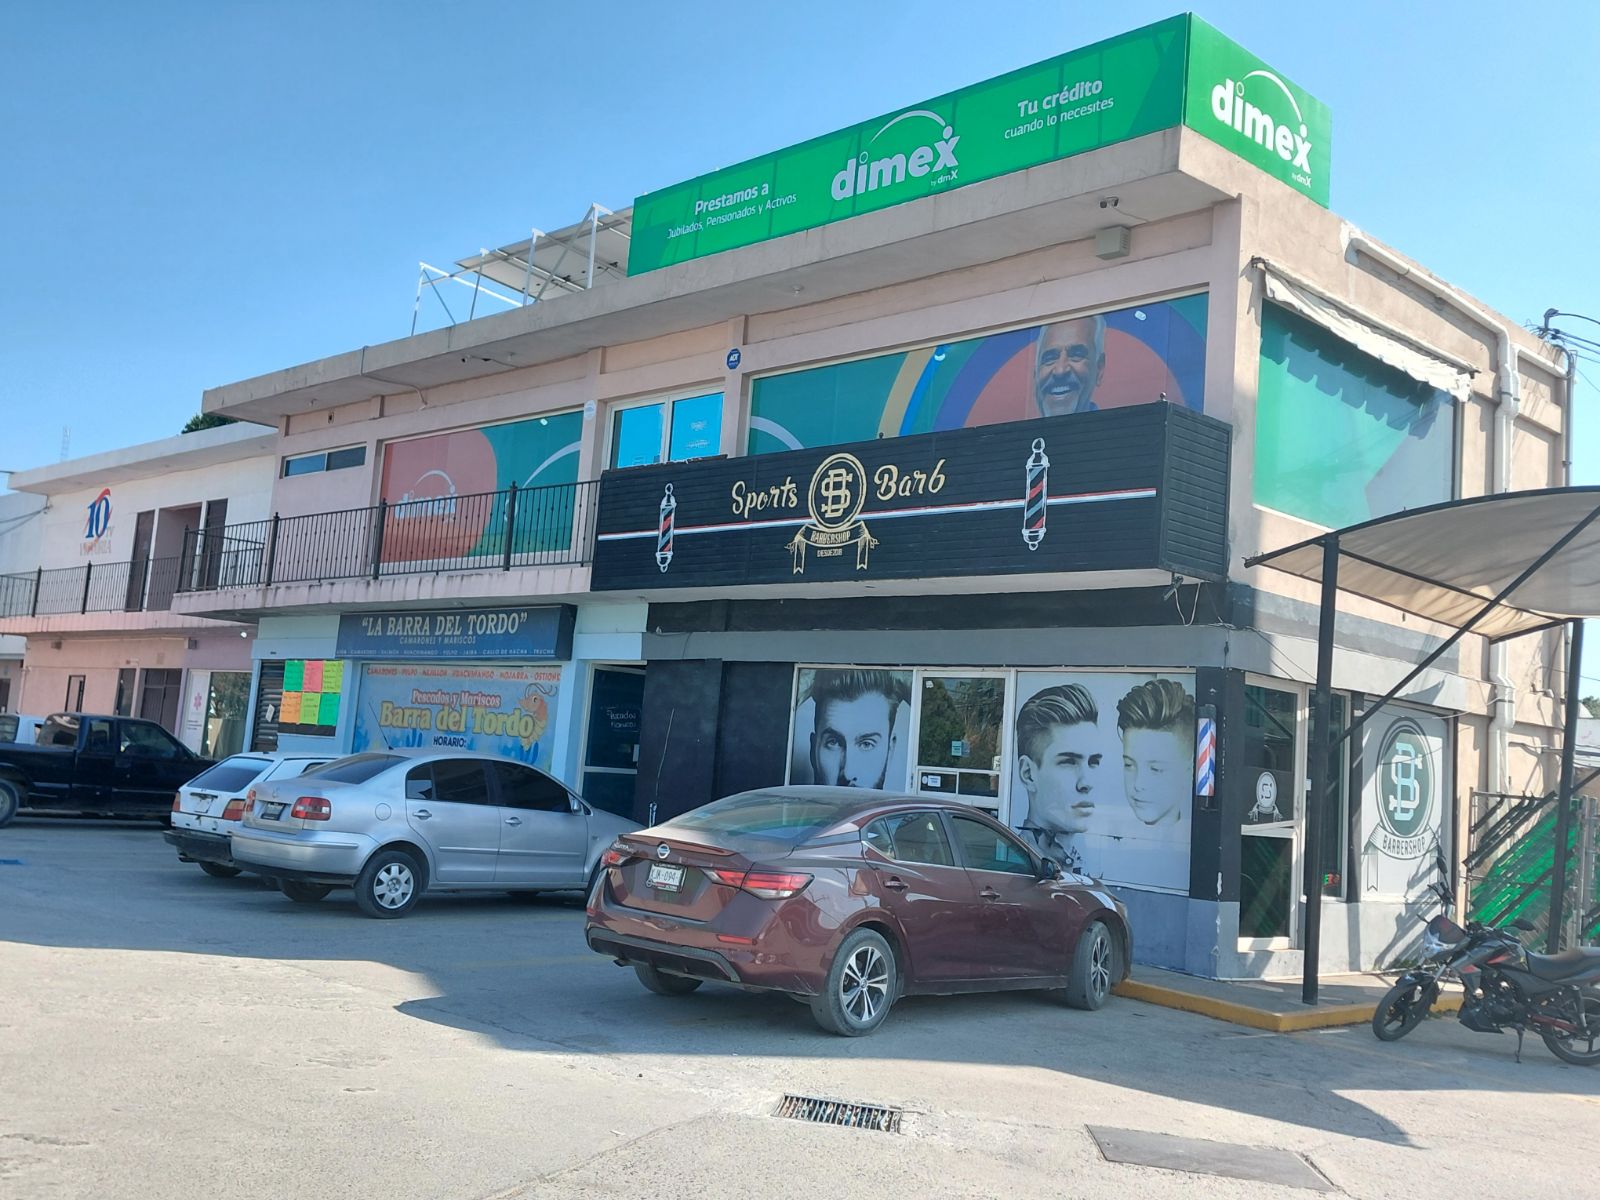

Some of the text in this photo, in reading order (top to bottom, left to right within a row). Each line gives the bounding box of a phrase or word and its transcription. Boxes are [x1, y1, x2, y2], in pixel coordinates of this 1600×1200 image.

[1018, 80, 1103, 118] Tu crédito
[1004, 97, 1115, 139] cuando lo necesites
[1211, 78, 1312, 175] dimex
[831, 134, 960, 201] dimex
[694, 183, 769, 215] Prestamos a
[706, 205, 756, 227] Pensionados
[757, 204, 764, 215] y
[765, 193, 797, 210] Activos
[395, 489, 459, 521] dimex
[731, 475, 798, 519] Sports
[85, 495, 110, 539] 10
[810, 530, 851, 545] BARBERSHOP
[386, 615, 430, 637] BARRA
[435, 614, 463, 636] DEL
[399, 636, 436, 645] CAMARONES
[443, 635, 476, 645] MARISCOS
[412, 689, 501, 709] Pescados y Mariscos
[380, 701, 536, 738] Barra del Tordo
[1382, 835, 1426, 856] BARBERSHOP
